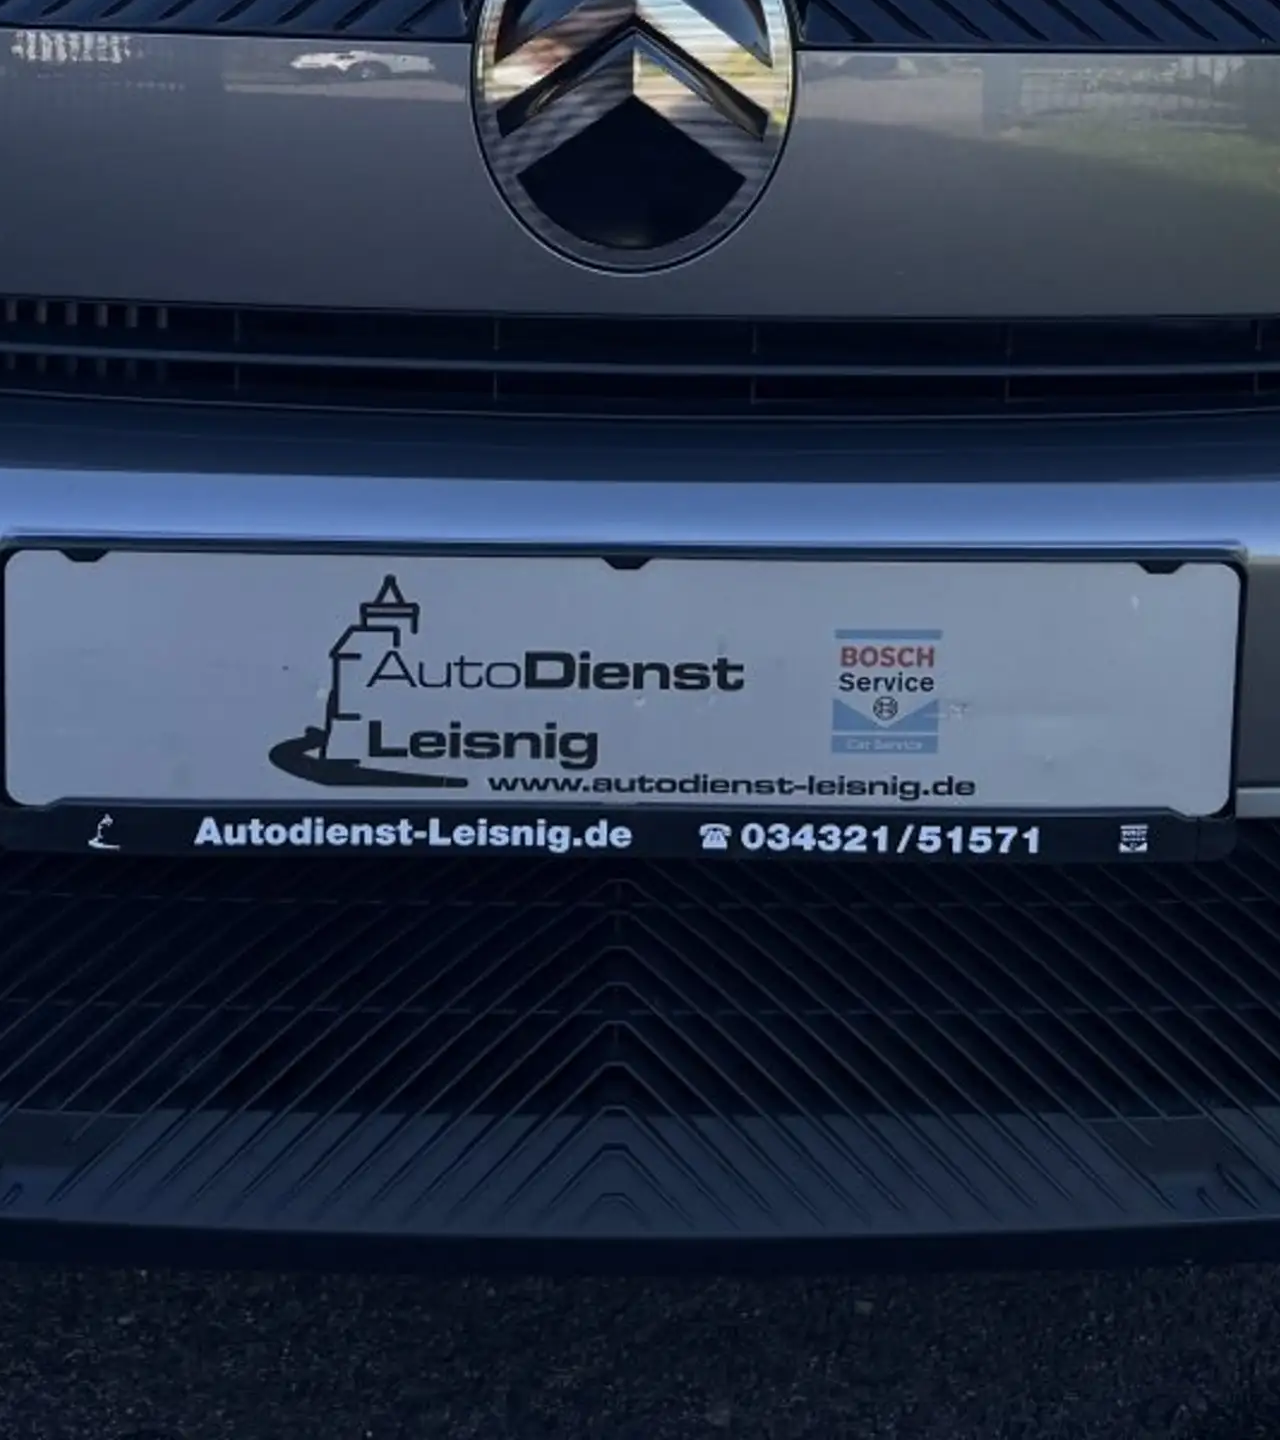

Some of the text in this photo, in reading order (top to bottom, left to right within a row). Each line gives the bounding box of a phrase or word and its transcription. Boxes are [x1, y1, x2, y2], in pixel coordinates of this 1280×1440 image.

[366, 650, 745, 691] AutoDienst
[840, 646, 935, 668] BOSCH
[838, 671, 935, 692] Service
[368, 720, 599, 770] Leisnig
[488, 773, 976, 801] www.autodienst-leisnig.de
[194, 816, 1040, 854] Autodienst-Leisnig.de 034321/51571
